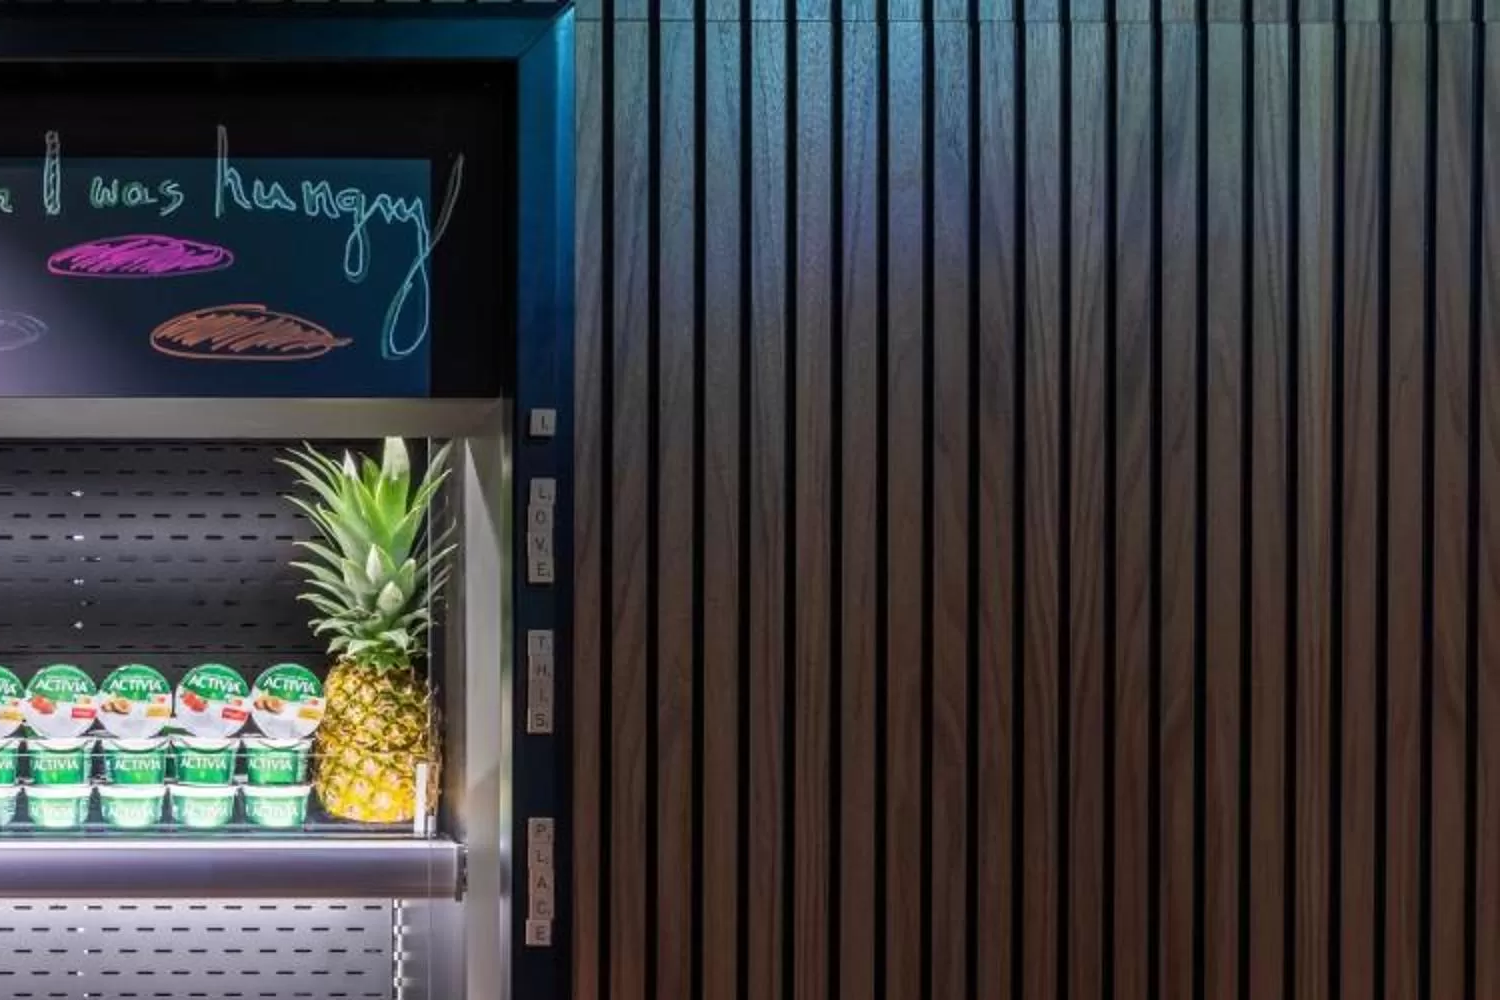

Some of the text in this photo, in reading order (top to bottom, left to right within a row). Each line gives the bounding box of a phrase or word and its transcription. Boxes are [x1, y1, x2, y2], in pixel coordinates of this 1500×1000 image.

[44, 130, 60, 215] I
[90, 176, 184, 217] was
[214, 124, 464, 360] hungry
[35, 678, 88, 693] ACTIVIA
[109, 677, 162, 692] ACTIVIA
[188, 674, 241, 692] ACTIVIA
[263, 676, 316, 694] ACTIVIA
